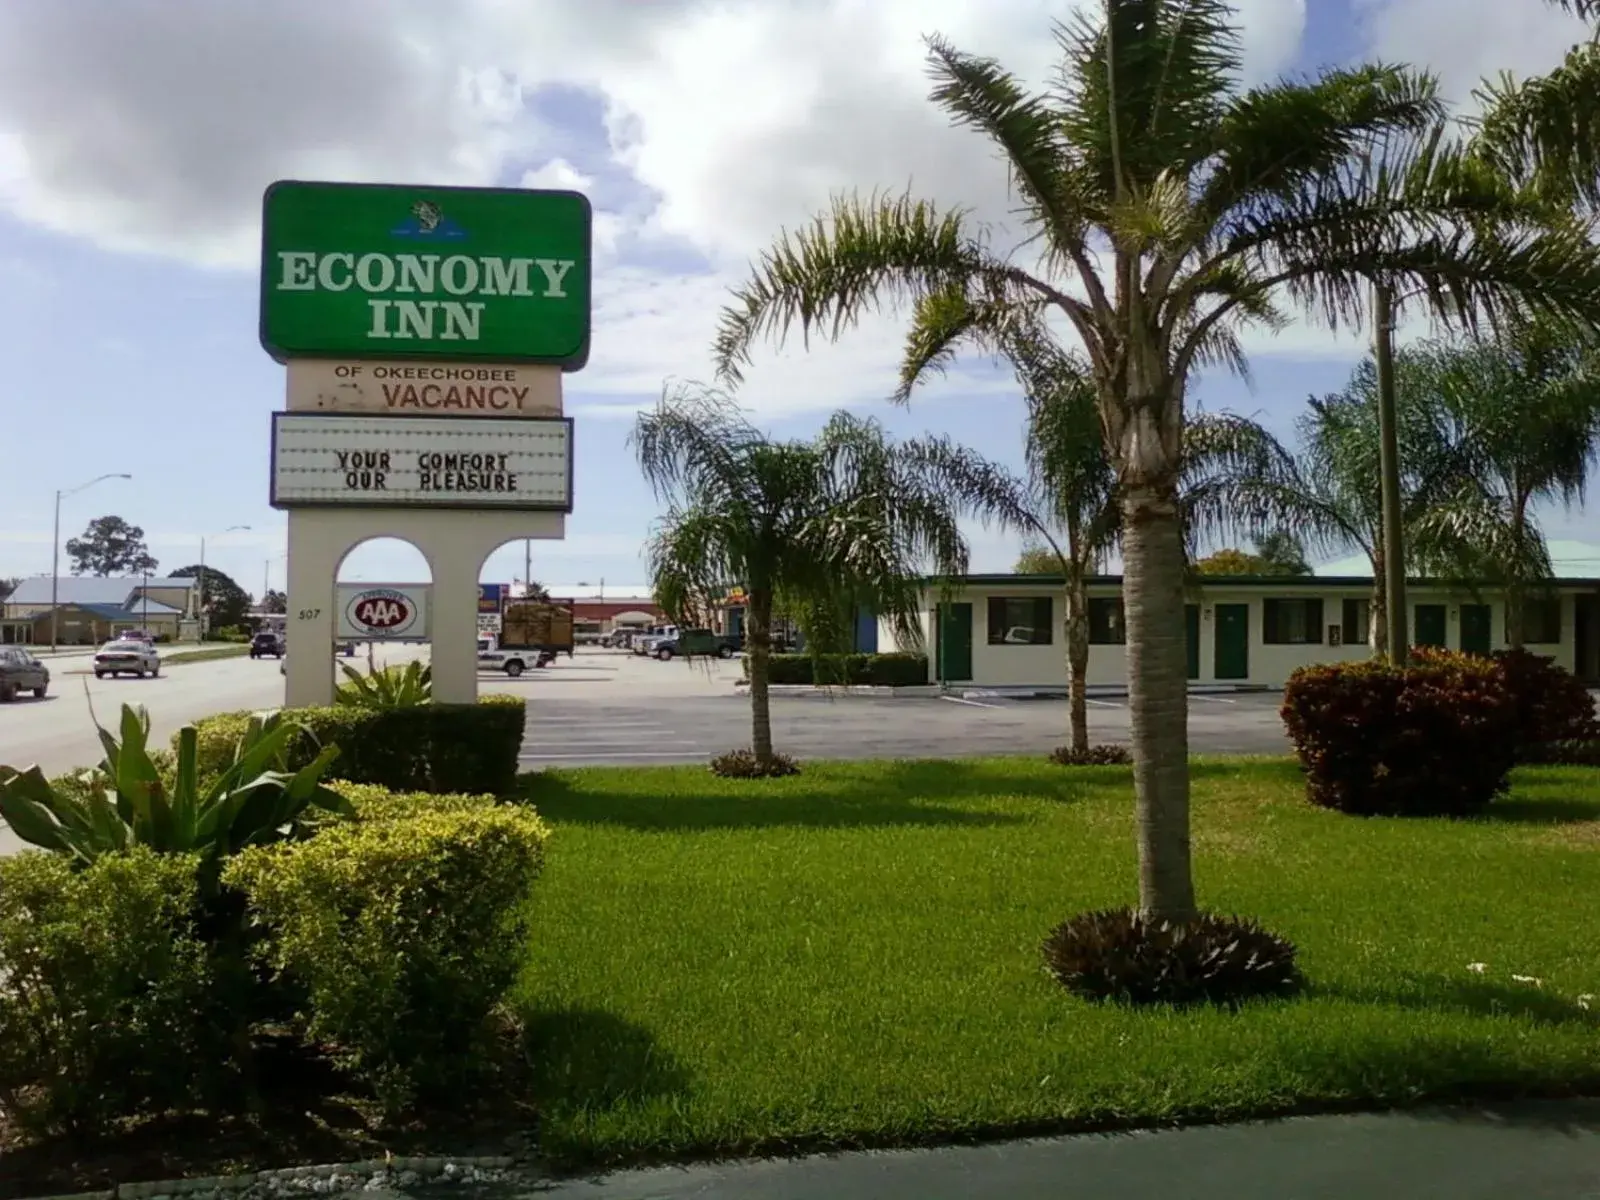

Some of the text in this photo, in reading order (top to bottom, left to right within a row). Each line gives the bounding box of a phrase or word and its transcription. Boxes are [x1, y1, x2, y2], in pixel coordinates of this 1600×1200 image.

[276, 251, 575, 297] ECONOMY
[367, 299, 485, 340] INN
[335, 366, 516, 382] OF OKEECHOBEE
[382, 384, 530, 410] VACANCY
[337, 452, 509, 471] YOUR COMFORT
[346, 472, 518, 492] OUR PLEASURE
[298, 608, 321, 621] 507
[361, 600, 400, 625] AAA
